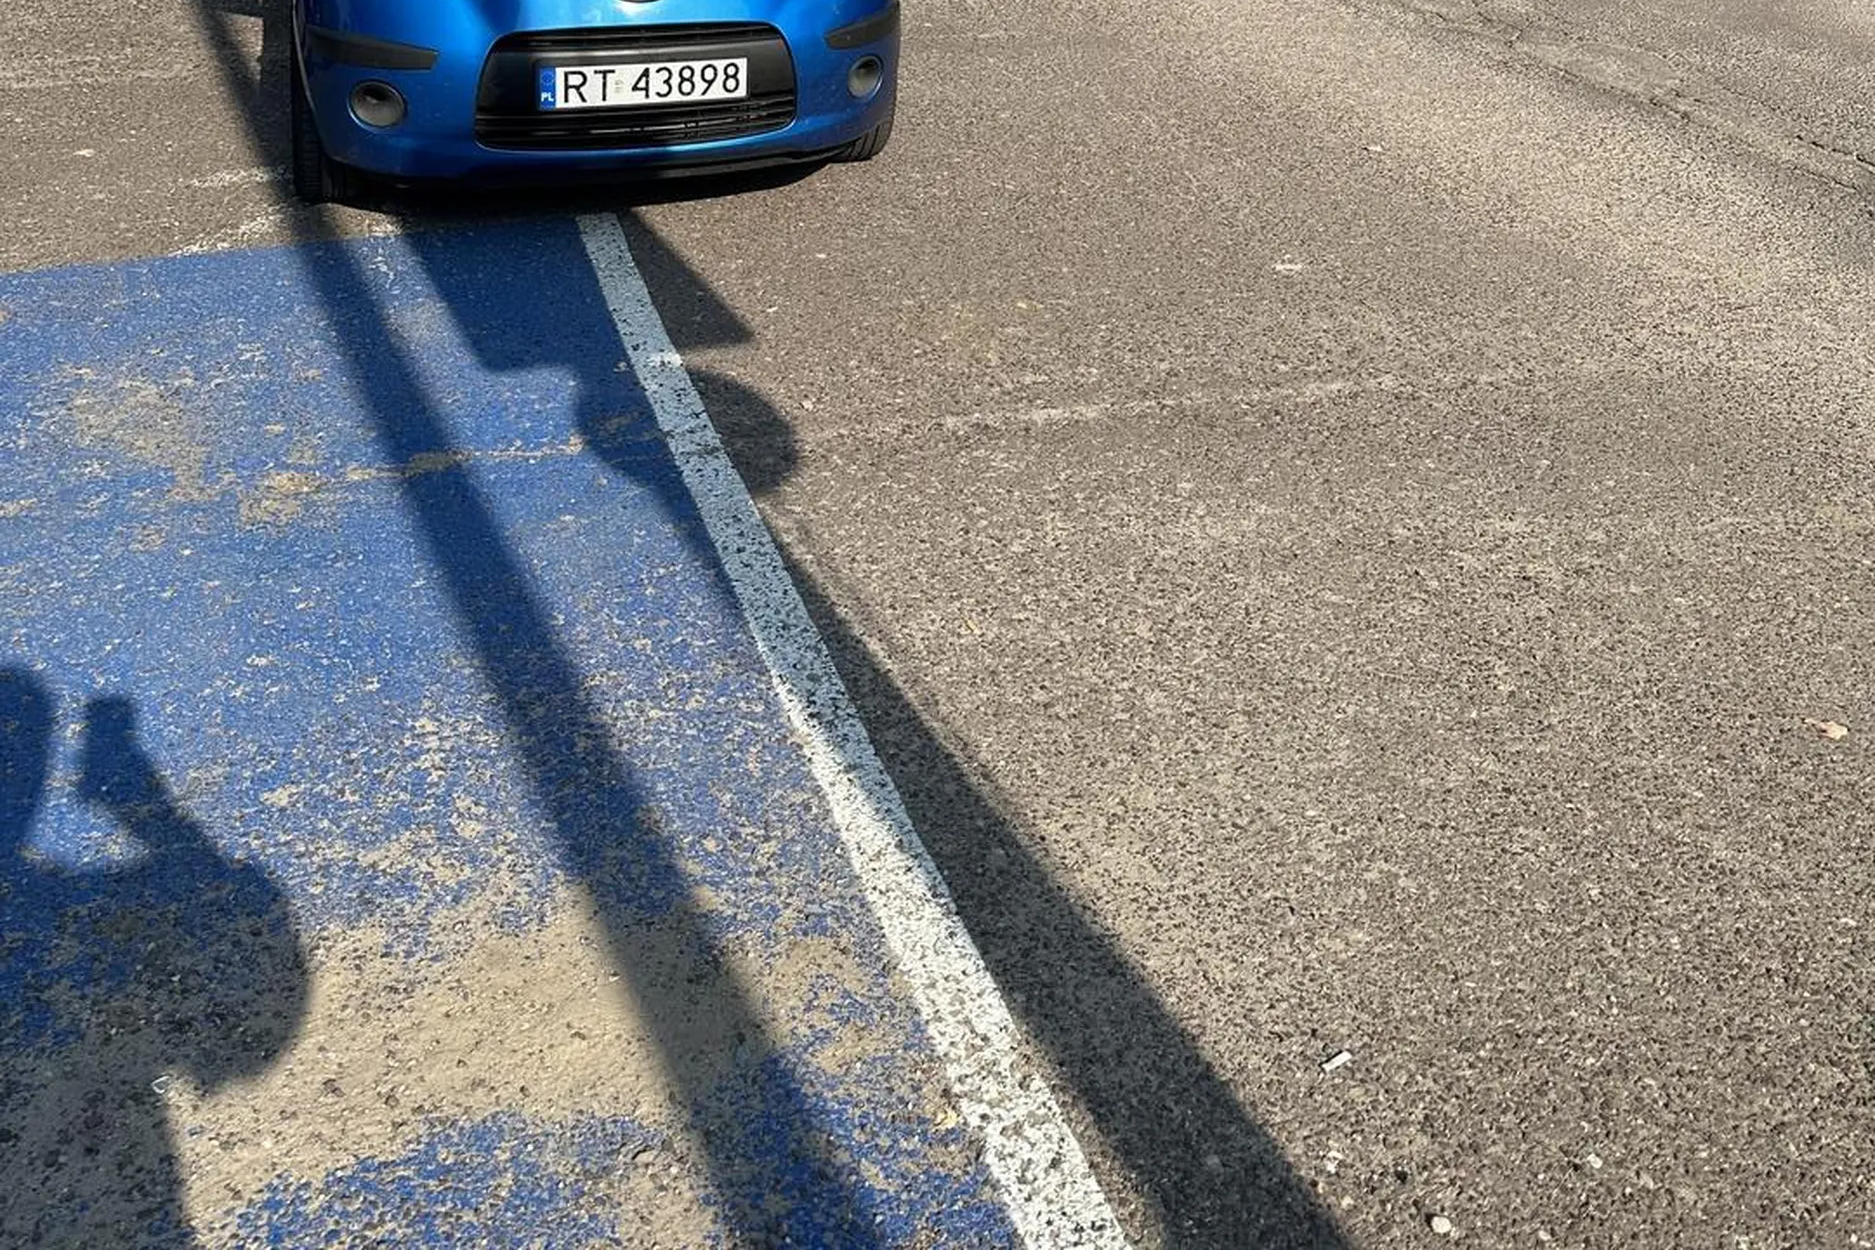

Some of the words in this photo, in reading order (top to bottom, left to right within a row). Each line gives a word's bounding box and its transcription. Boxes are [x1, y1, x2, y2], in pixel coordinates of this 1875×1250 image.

[563, 69, 616, 104] RT
[631, 62, 740, 99] 43898
[541, 92, 554, 102] PL
